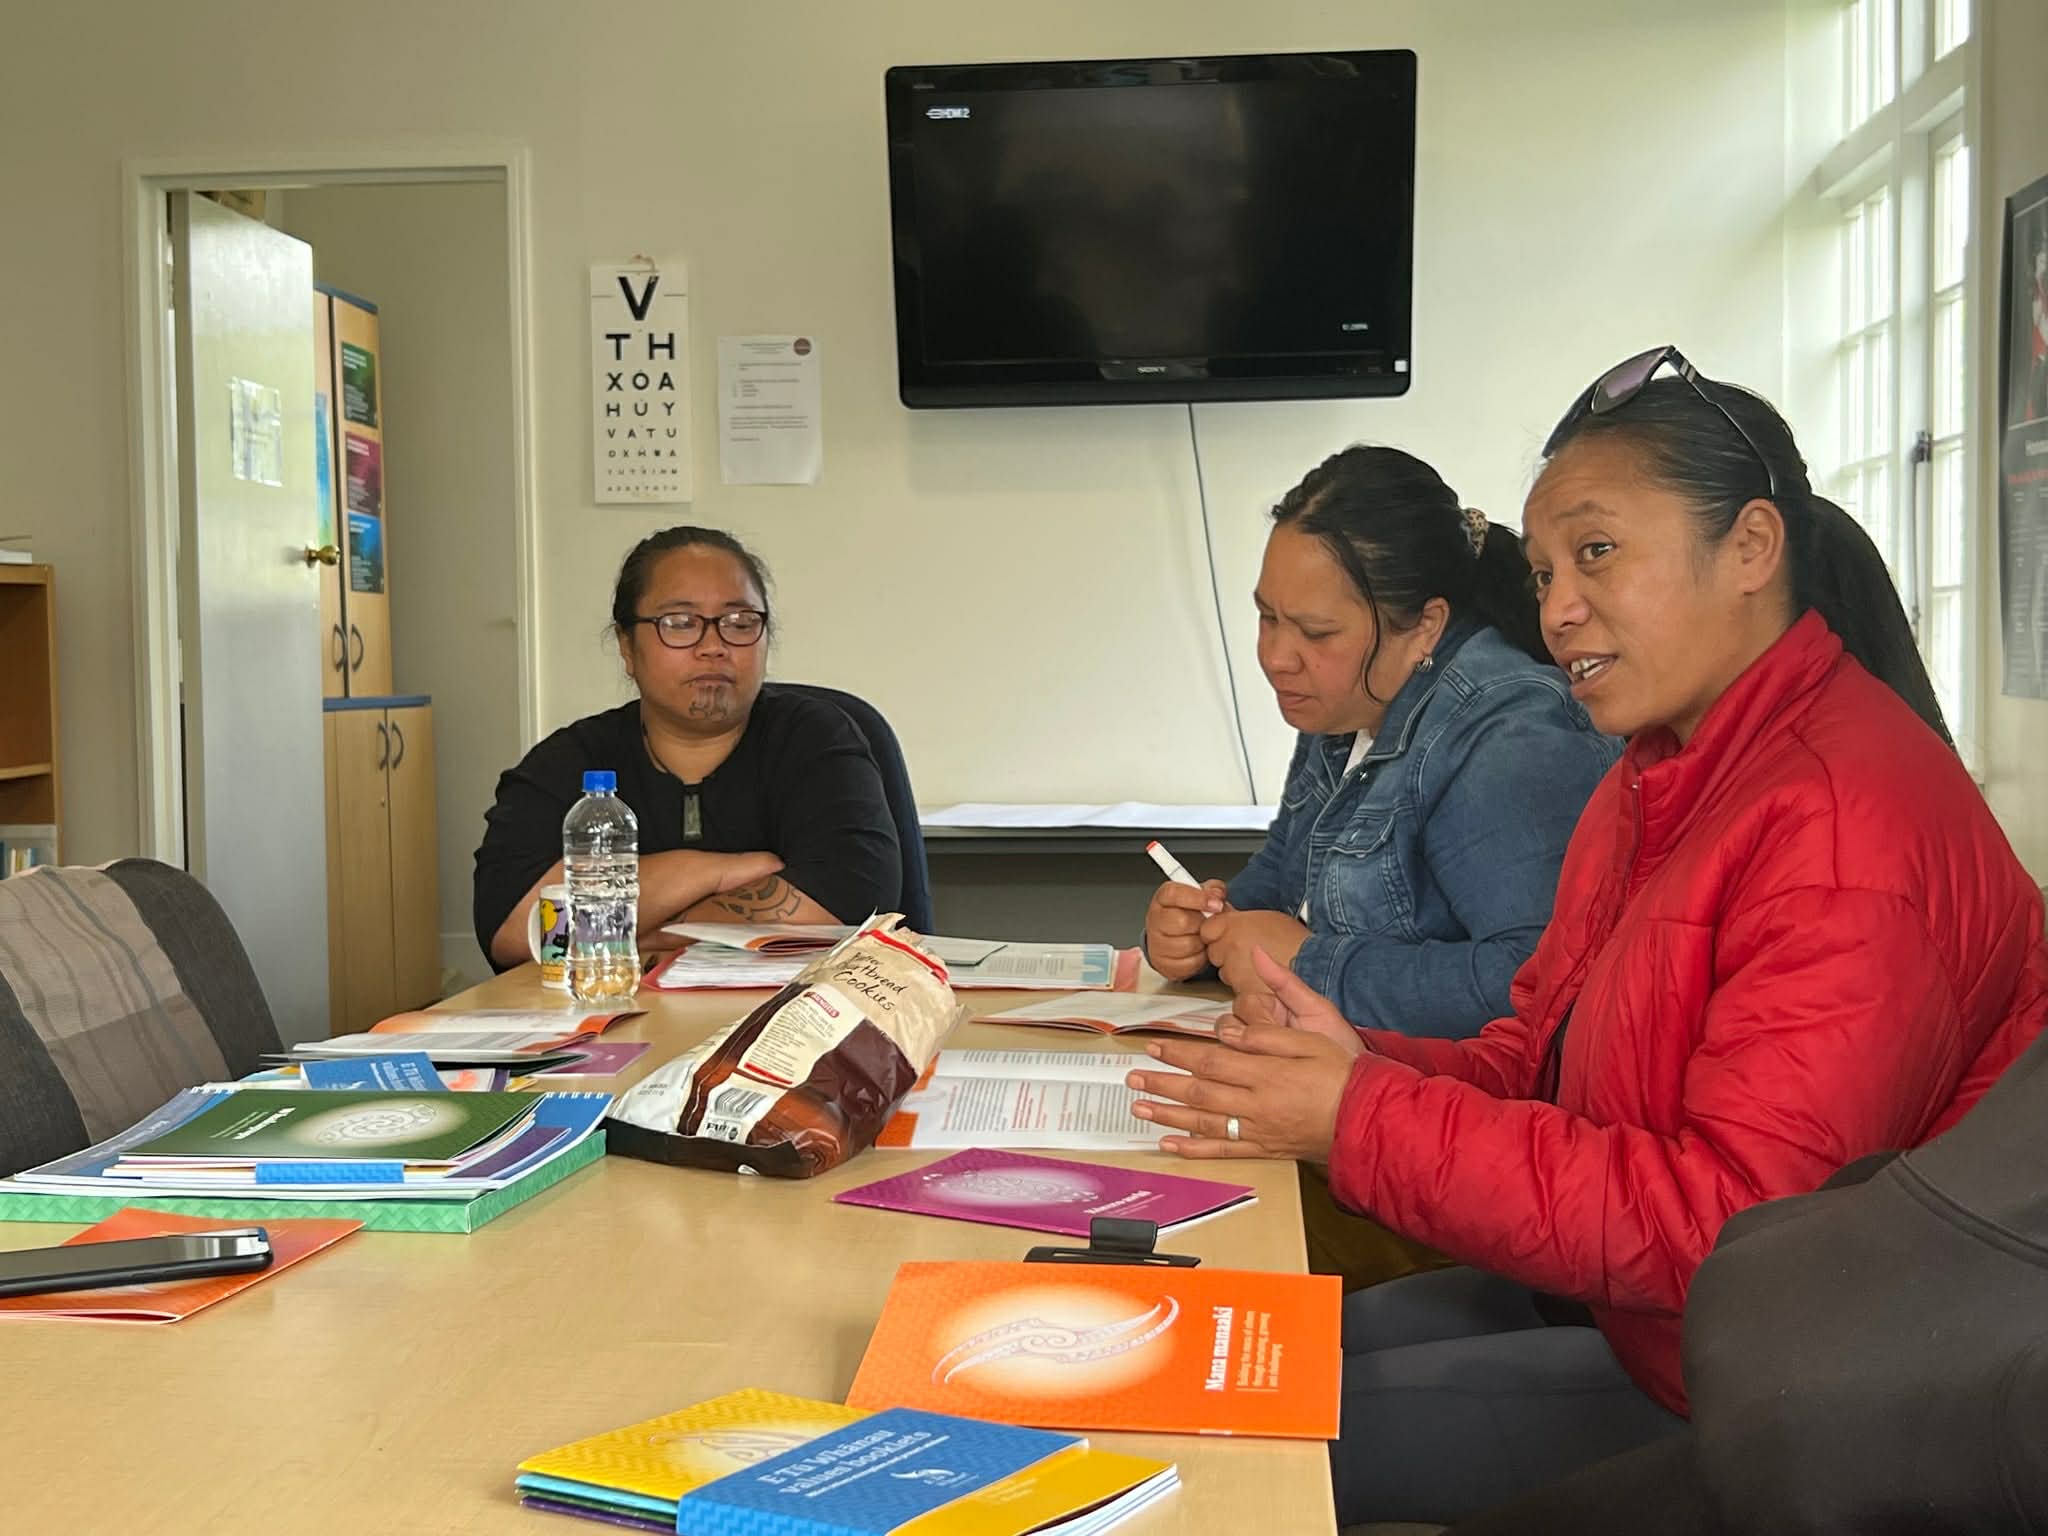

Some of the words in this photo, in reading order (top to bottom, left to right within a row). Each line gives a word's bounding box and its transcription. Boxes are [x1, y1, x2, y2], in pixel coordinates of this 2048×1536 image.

[617, 276, 660, 321] V
[605, 333, 631, 361] T
[648, 333, 675, 361] H
[606, 372, 624, 391] X
[632, 372, 650, 391] O
[658, 372, 676, 391] A
[606, 403, 621, 417] H
[634, 403, 648, 417] U
[663, 402, 675, 417] Y
[833, 971, 896, 1010] Cookies
[1212, 1306, 1233, 1358] manaaki
[1204, 1359, 1227, 1393] Mana
[845, 1431, 932, 1468] booklets
[756, 1474, 787, 1485] E
